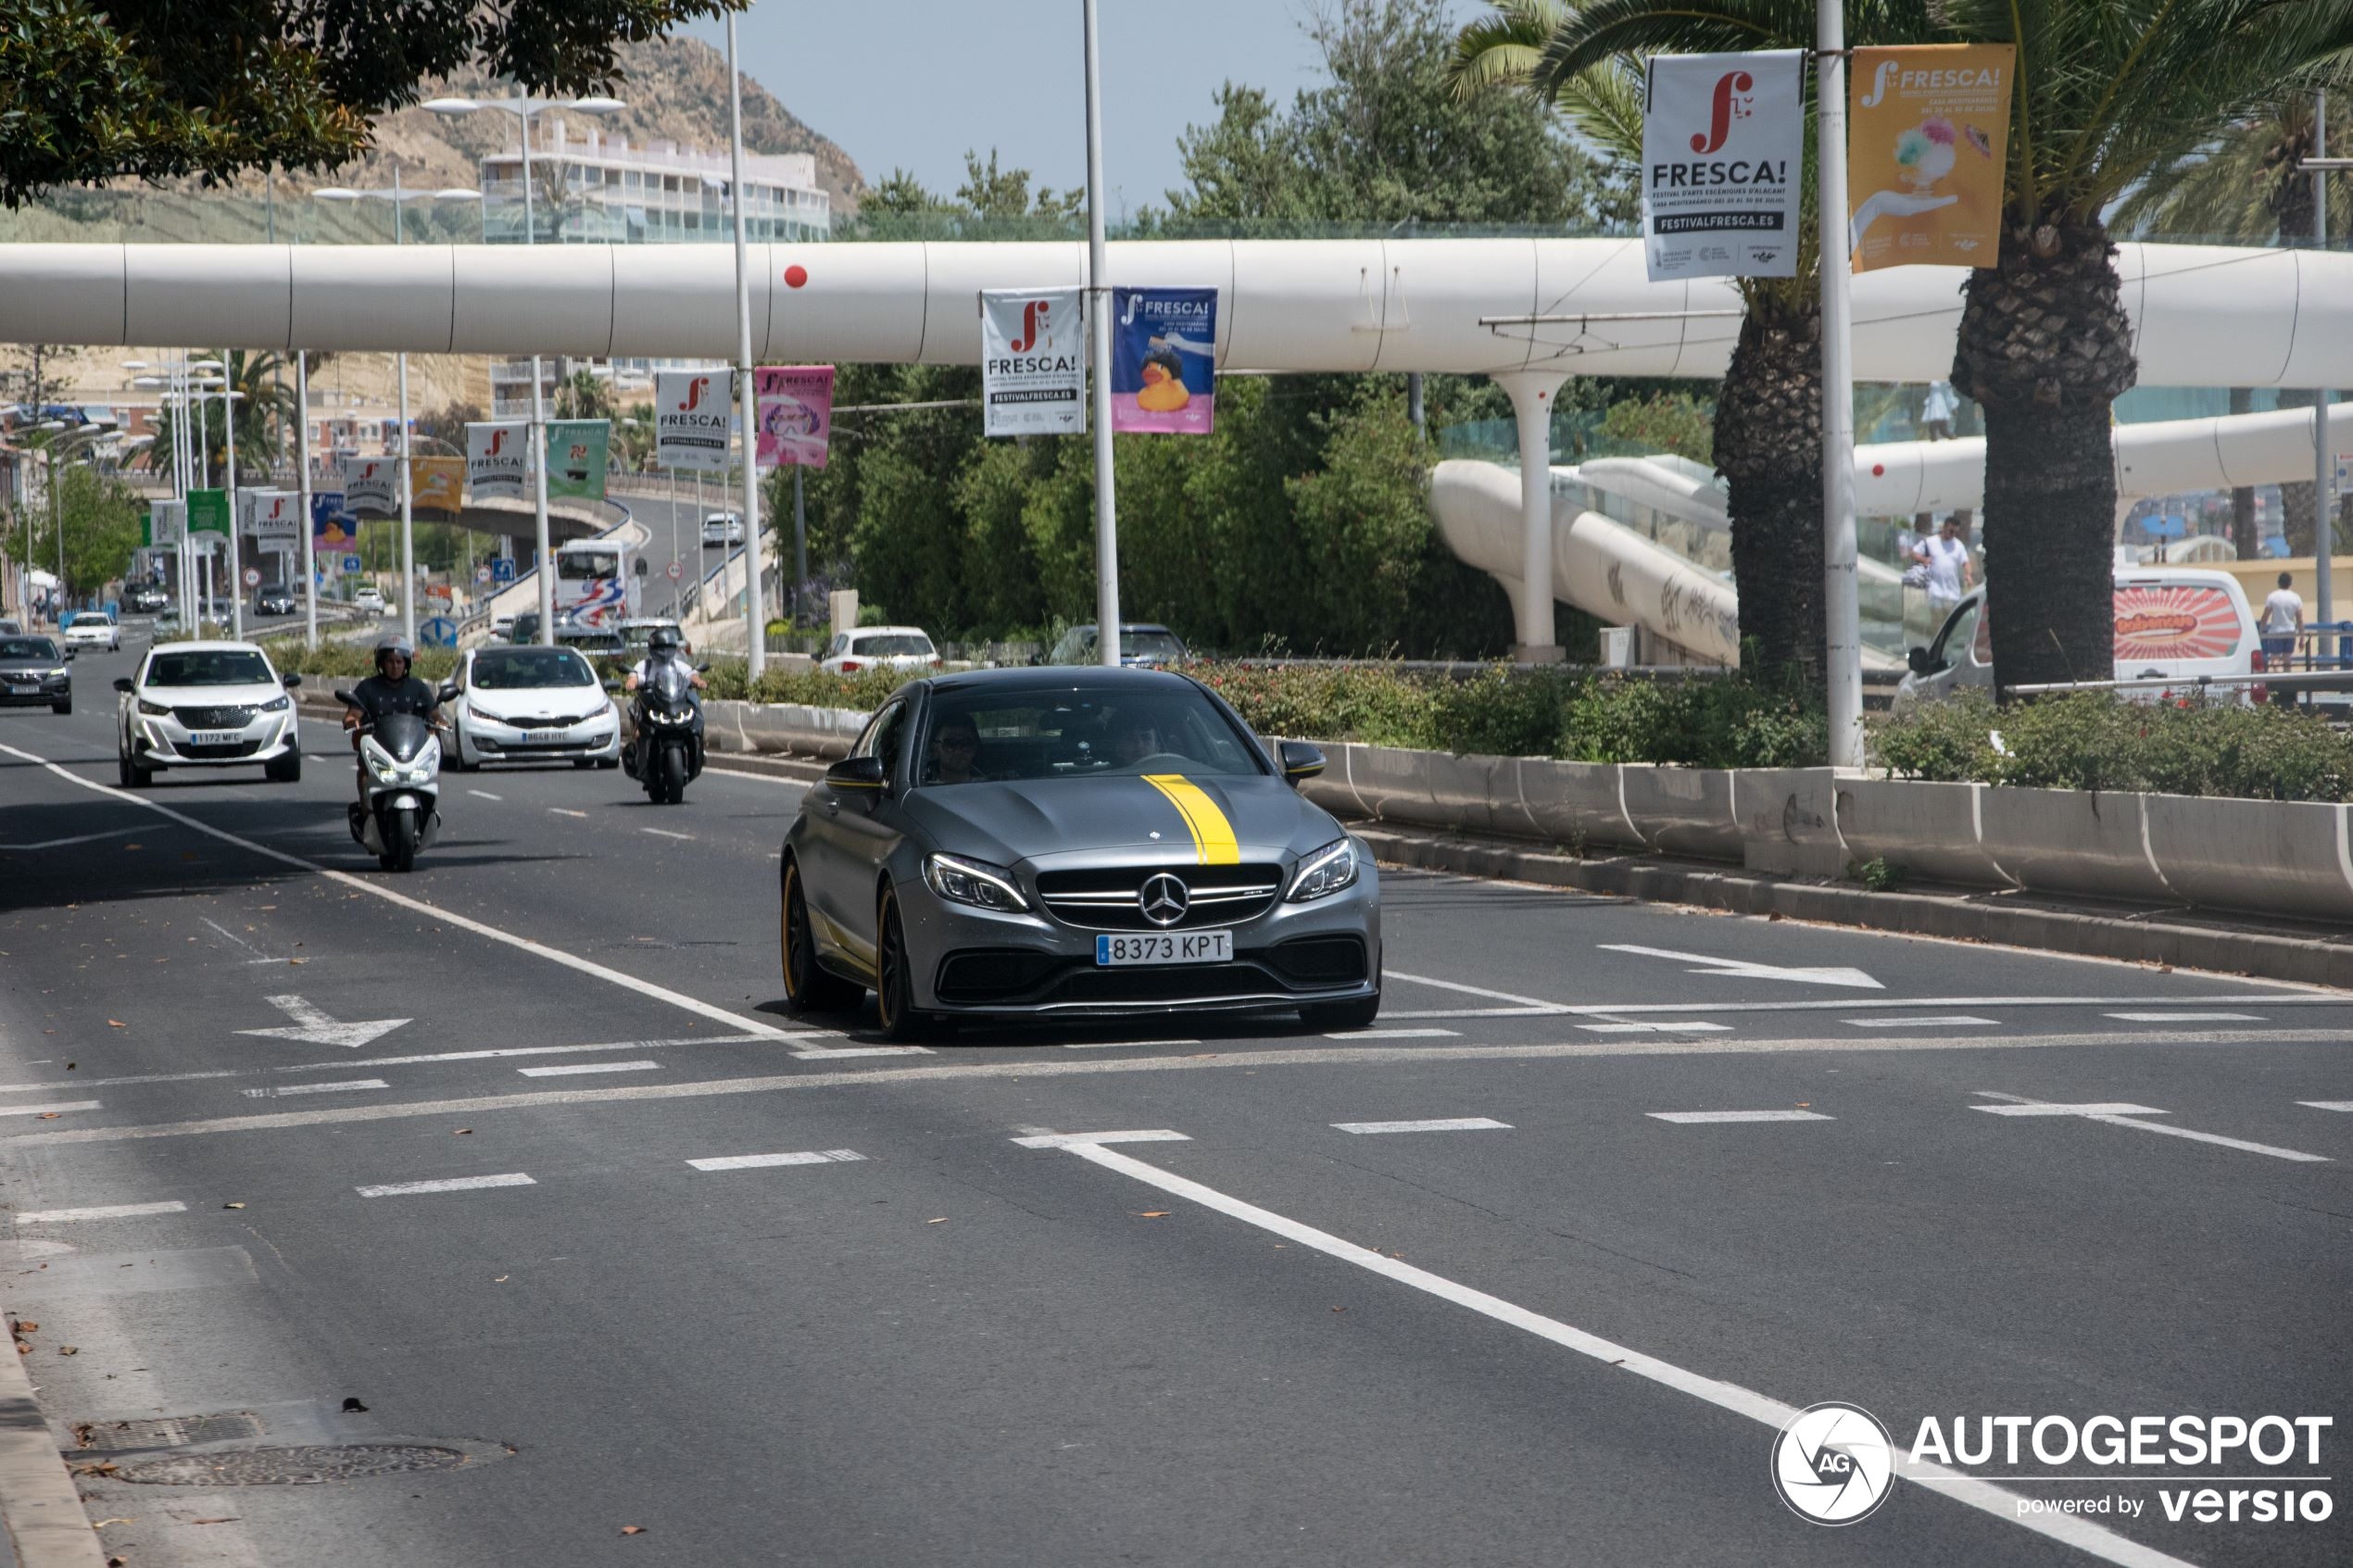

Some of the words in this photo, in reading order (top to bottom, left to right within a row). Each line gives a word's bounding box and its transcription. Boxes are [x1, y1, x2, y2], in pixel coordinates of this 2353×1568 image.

[1900, 68, 2001, 88] FRESCA!
[1653, 160, 1786, 188] FRESCA!
[1661, 215, 1774, 231] FESTIVALFRESCA.ES
[1145, 301, 1208, 315] FRESCA!
[988, 356, 1076, 375] FRESCA!
[661, 414, 726, 428] FRESCA!
[1113, 937, 1174, 960] 8373
[1182, 935, 1225, 958] KPT
